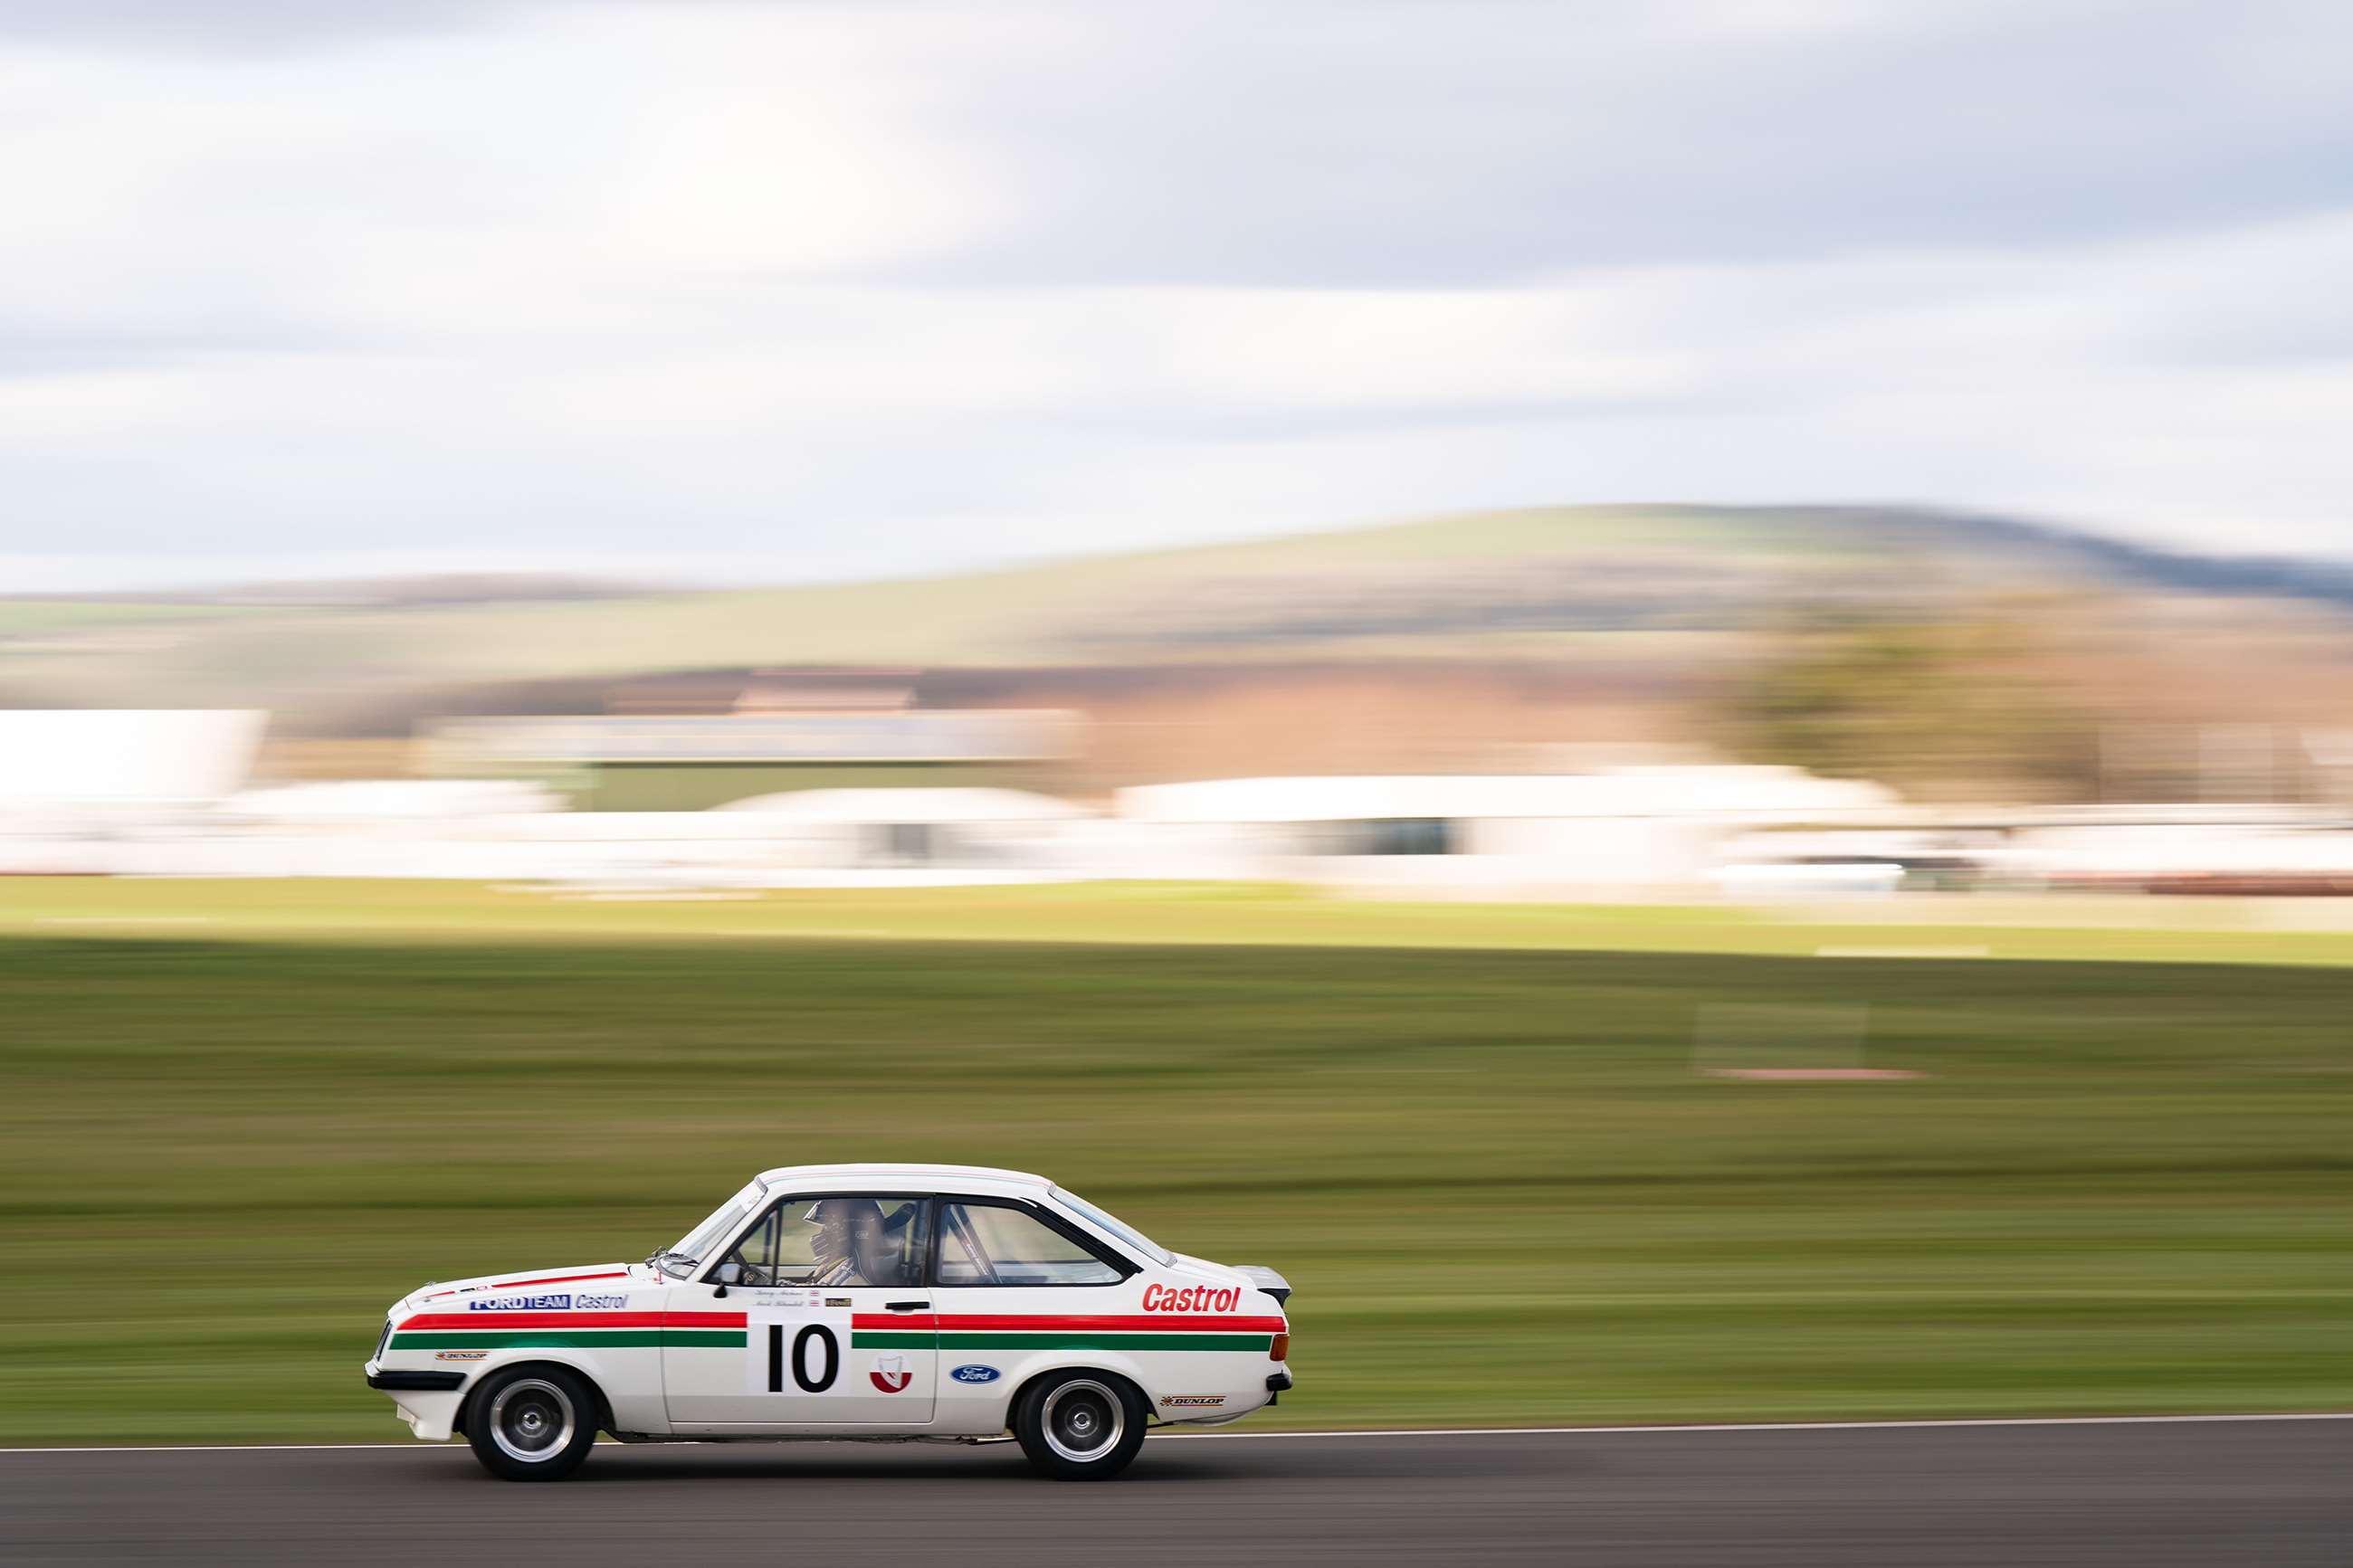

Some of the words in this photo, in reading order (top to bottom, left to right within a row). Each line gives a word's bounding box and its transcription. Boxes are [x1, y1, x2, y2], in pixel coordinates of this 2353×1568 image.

[576, 1294, 628, 1309] Castrol
[1142, 1283, 1242, 1312] Castrol
[767, 1323, 840, 1393] 10
[959, 1367, 990, 1381] Ford
